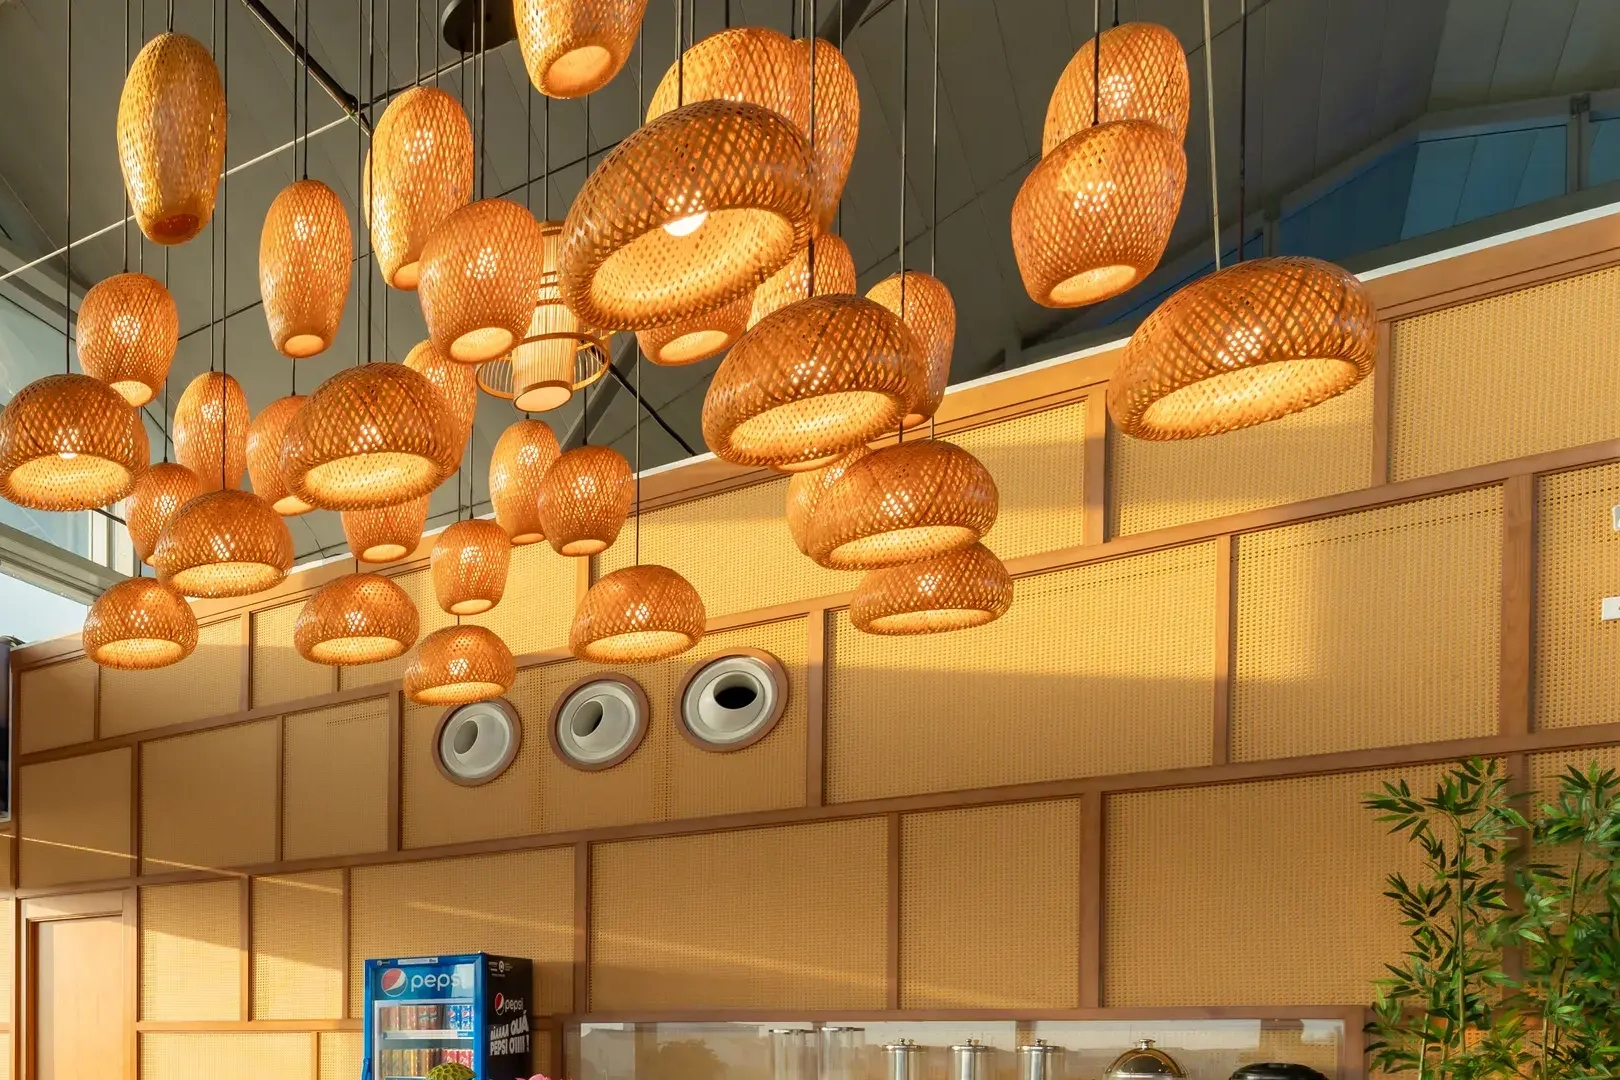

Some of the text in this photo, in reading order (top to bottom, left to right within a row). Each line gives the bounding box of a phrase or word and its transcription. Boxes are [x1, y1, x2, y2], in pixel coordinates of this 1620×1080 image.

[410, 972, 461, 993] peps
[504, 998, 524, 1013] pepsi
[490, 1038, 508, 1056] PEPSI
